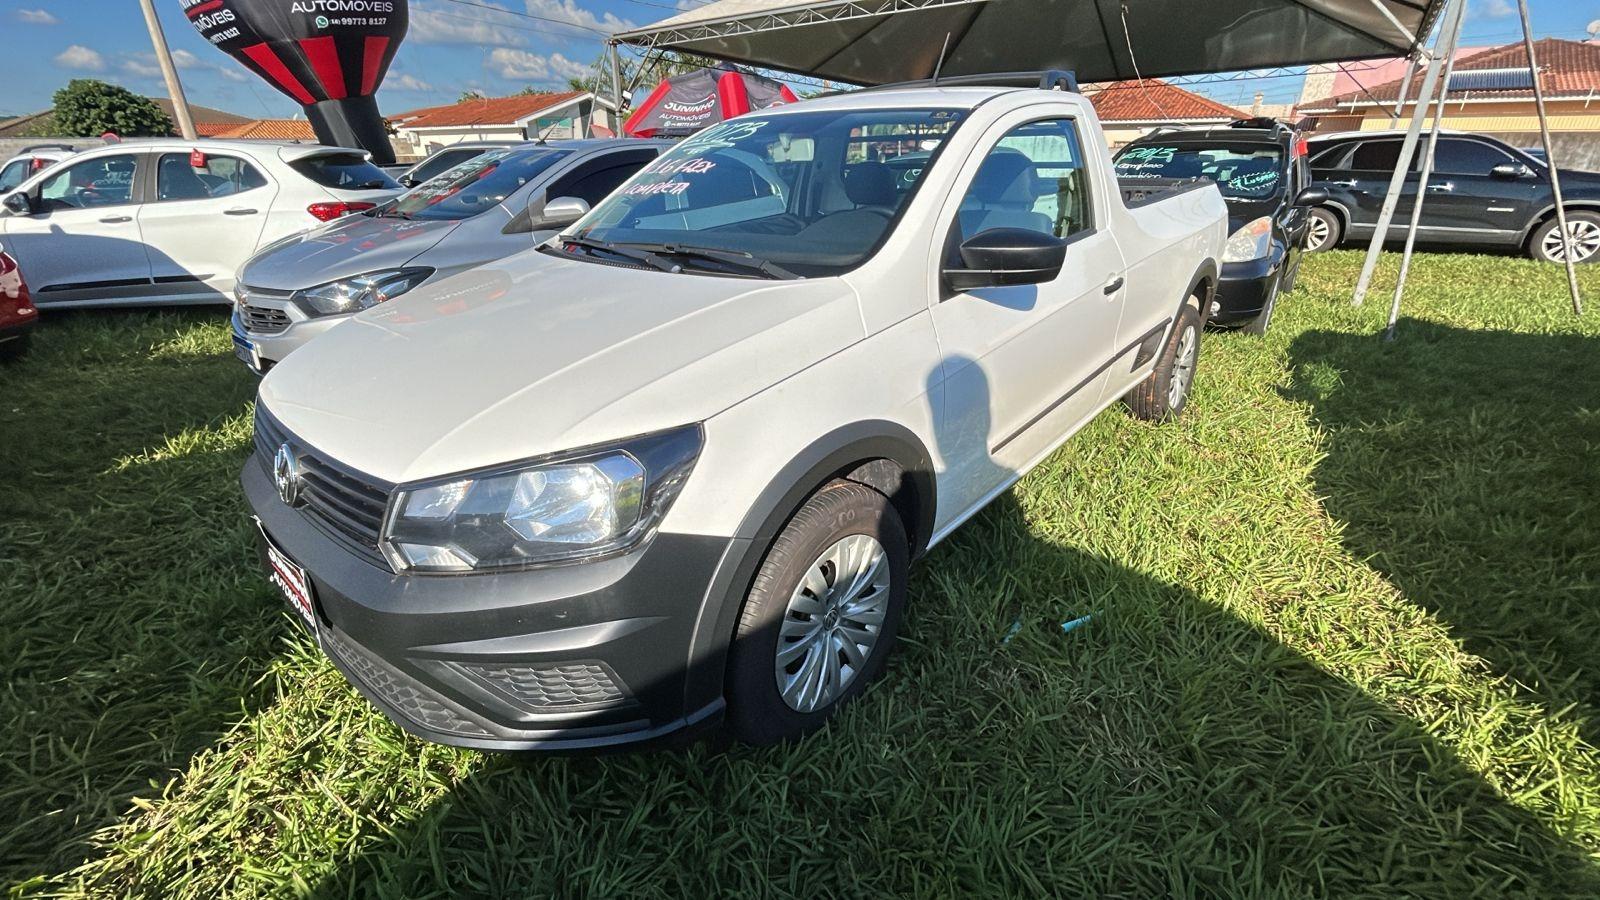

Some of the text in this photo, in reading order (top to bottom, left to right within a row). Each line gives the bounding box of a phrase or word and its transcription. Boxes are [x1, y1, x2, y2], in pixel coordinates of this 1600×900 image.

[341, 17, 367, 26] 99773
[368, 17, 387, 25] 8127
[664, 99, 715, 112] JUNINHO
